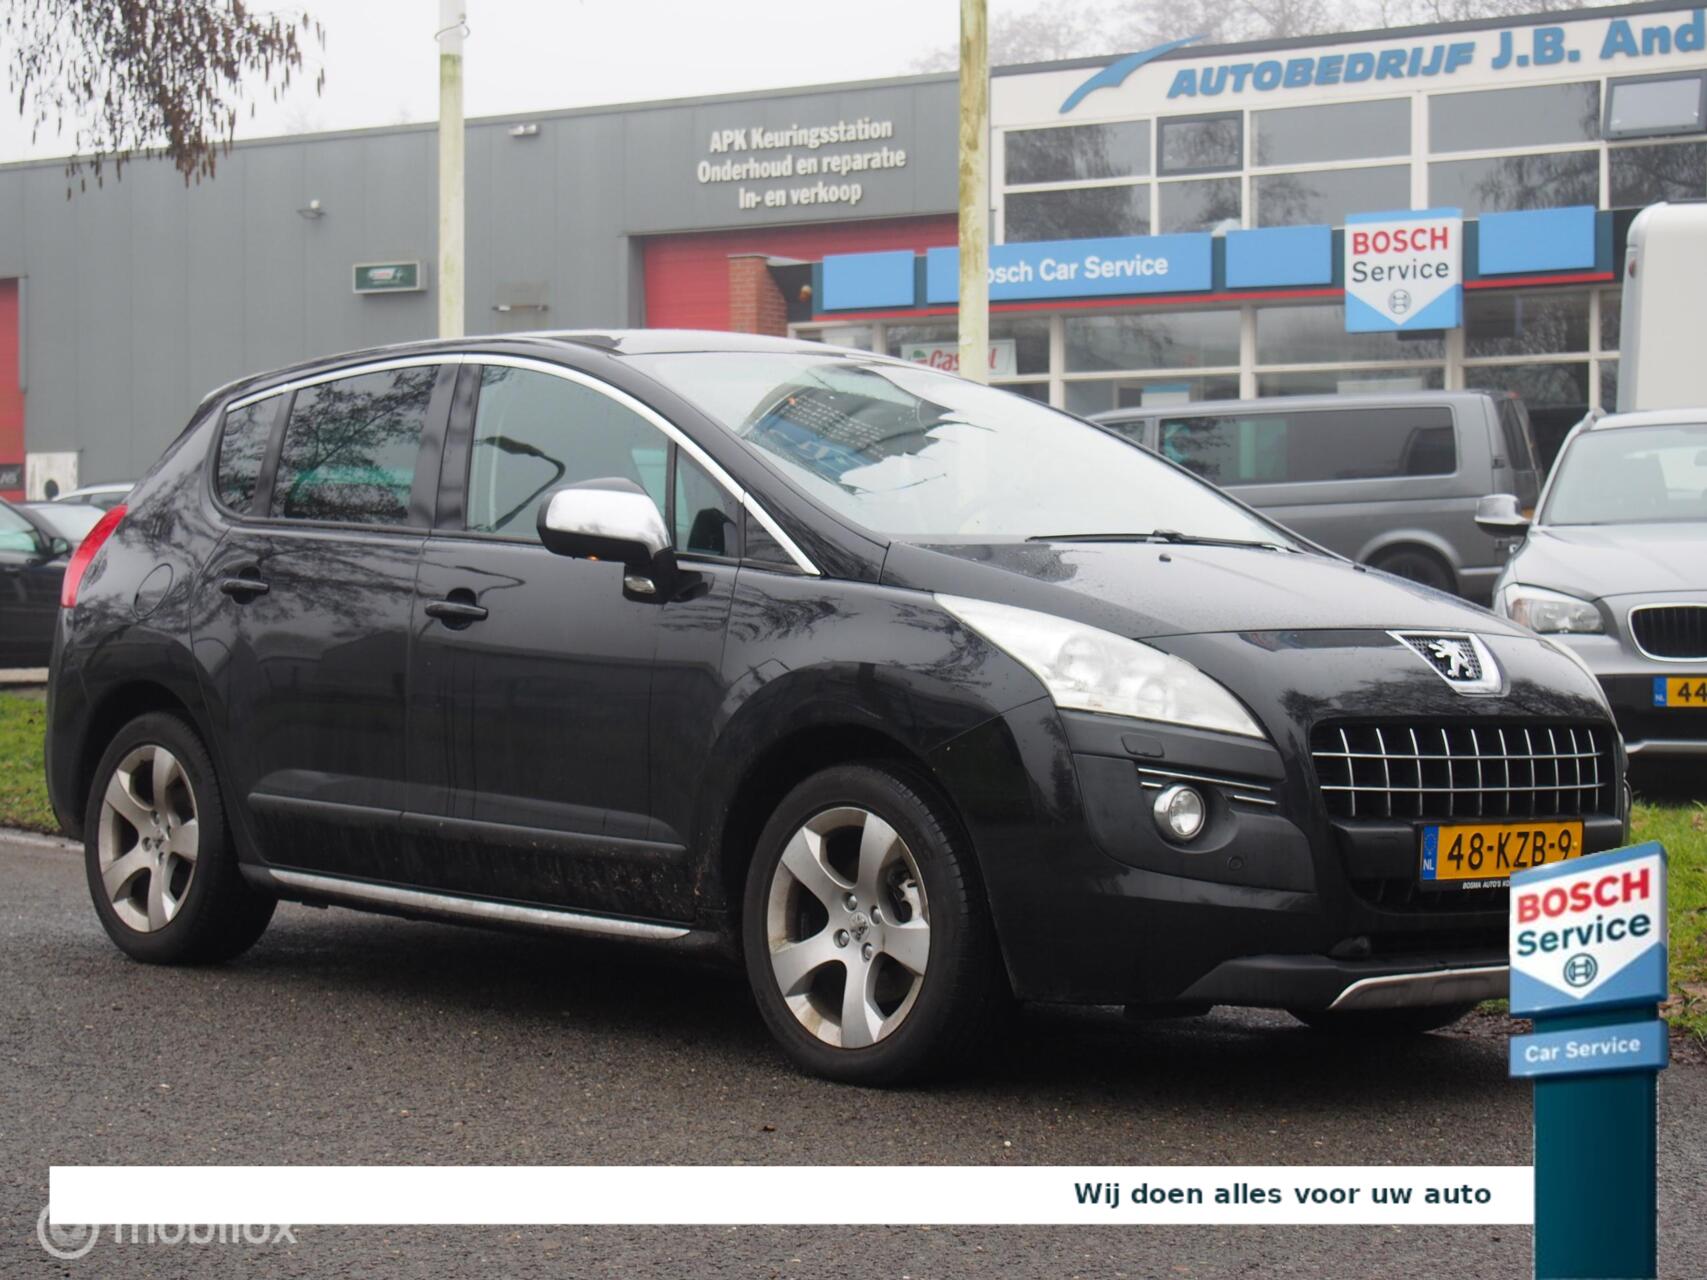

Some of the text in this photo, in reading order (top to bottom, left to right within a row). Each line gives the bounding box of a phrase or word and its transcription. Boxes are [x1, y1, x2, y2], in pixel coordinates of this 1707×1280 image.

[1166, 8, 1705, 99] AUTOBEDRIJF J.B. And
[710, 117, 892, 152] APK Keuringsstation
[697, 147, 906, 183] Onderhoud en reparatie
[739, 181, 862, 209] In- en verkoop
[1352, 227, 1448, 255] BOSCH
[987, 254, 1169, 284] osch Car Service
[1351, 258, 1449, 283] Service
[1677, 681, 1707, 703] 44
[1423, 858, 1435, 871] NL
[1447, 829, 1573, 871] 48-KZB-9
